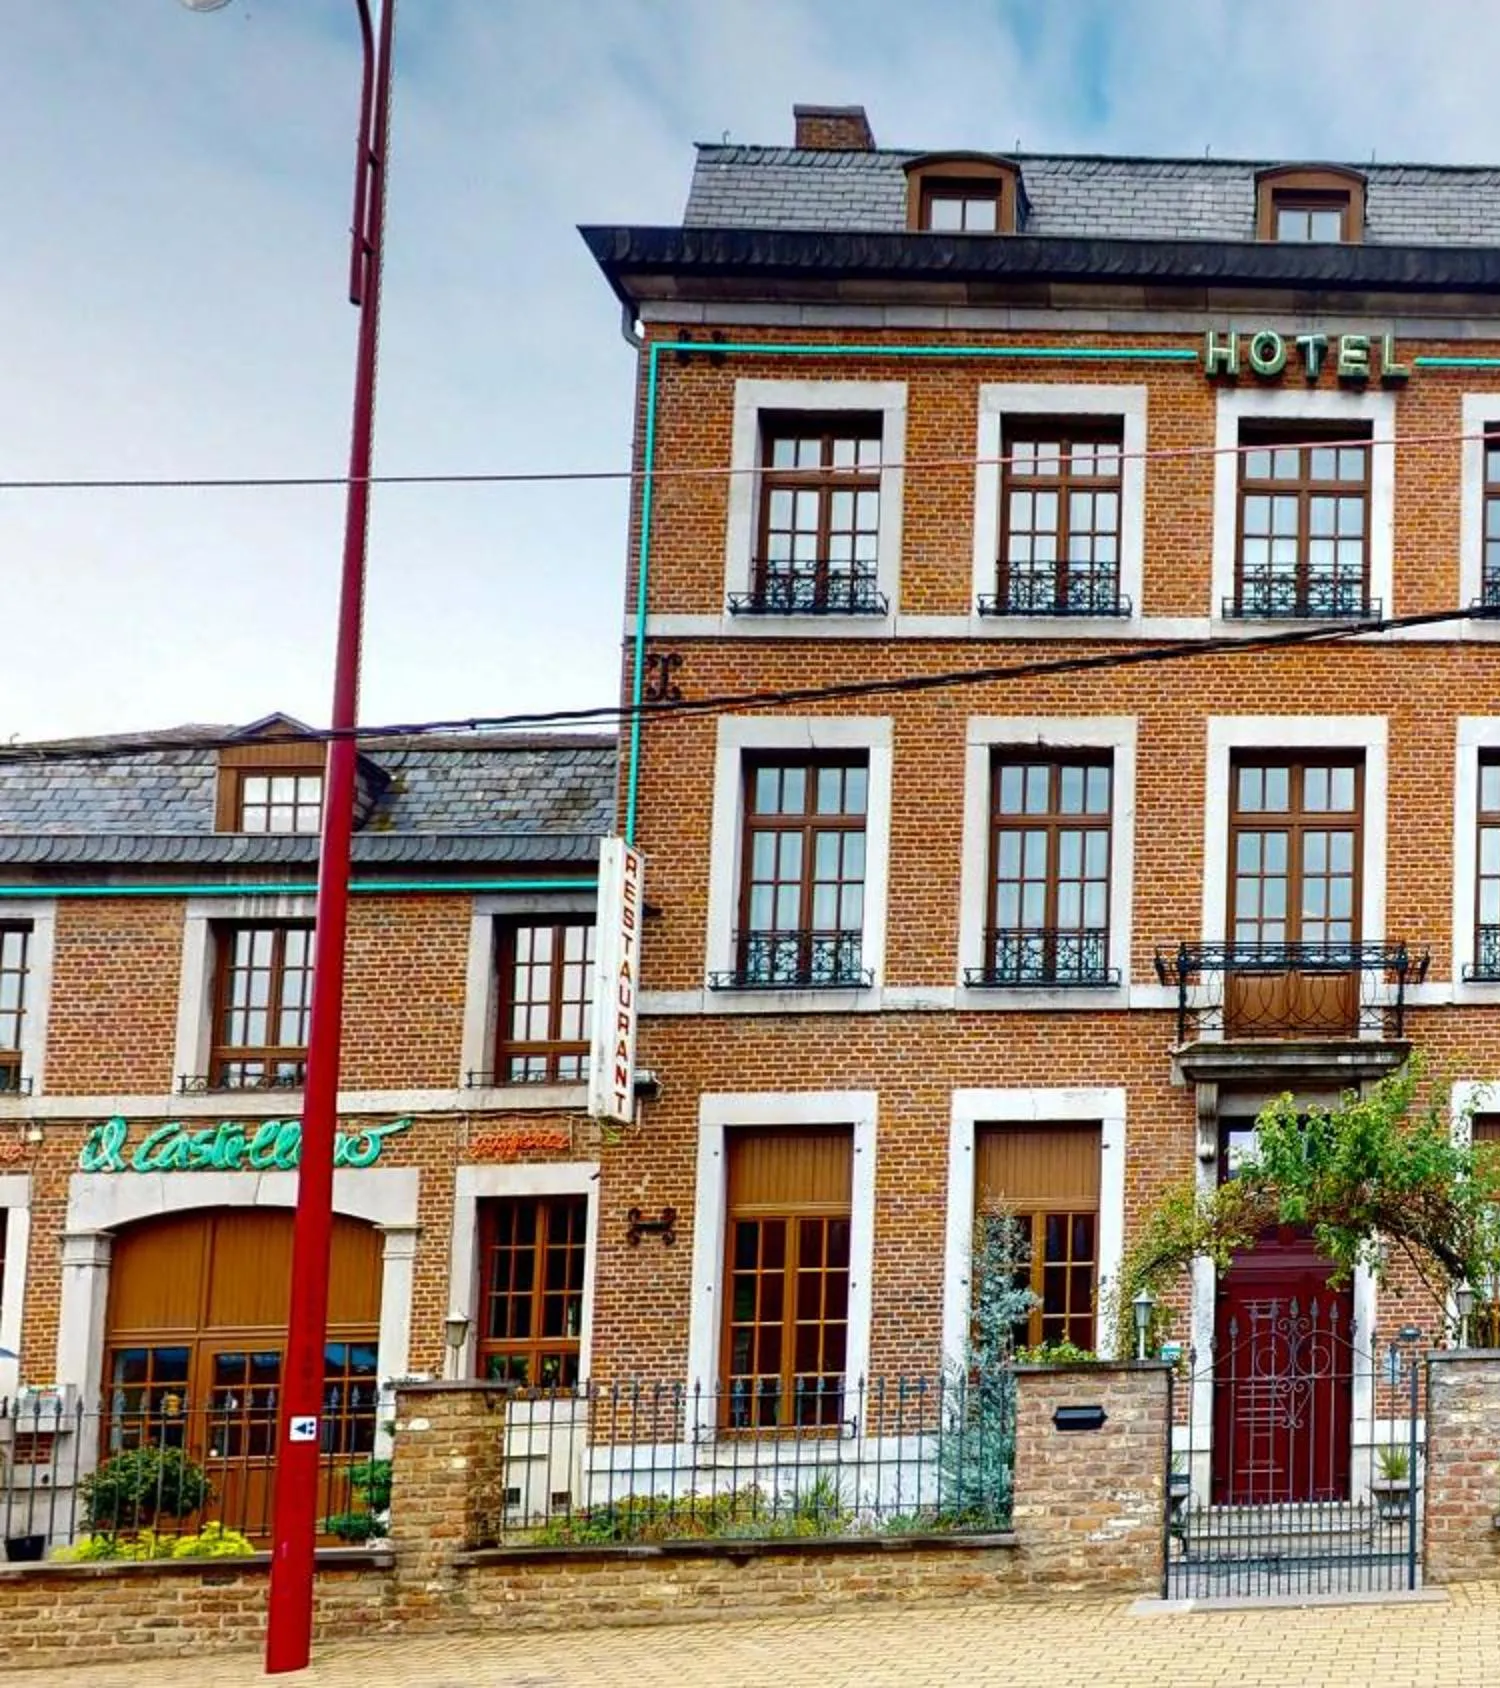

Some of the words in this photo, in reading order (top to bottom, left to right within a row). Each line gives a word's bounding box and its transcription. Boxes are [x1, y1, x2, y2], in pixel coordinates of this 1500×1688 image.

[1204, 330, 1410, 382] HOTEL
[613, 853, 638, 1114] RESTAURANT
[131, 1114, 412, 1170] Castello
